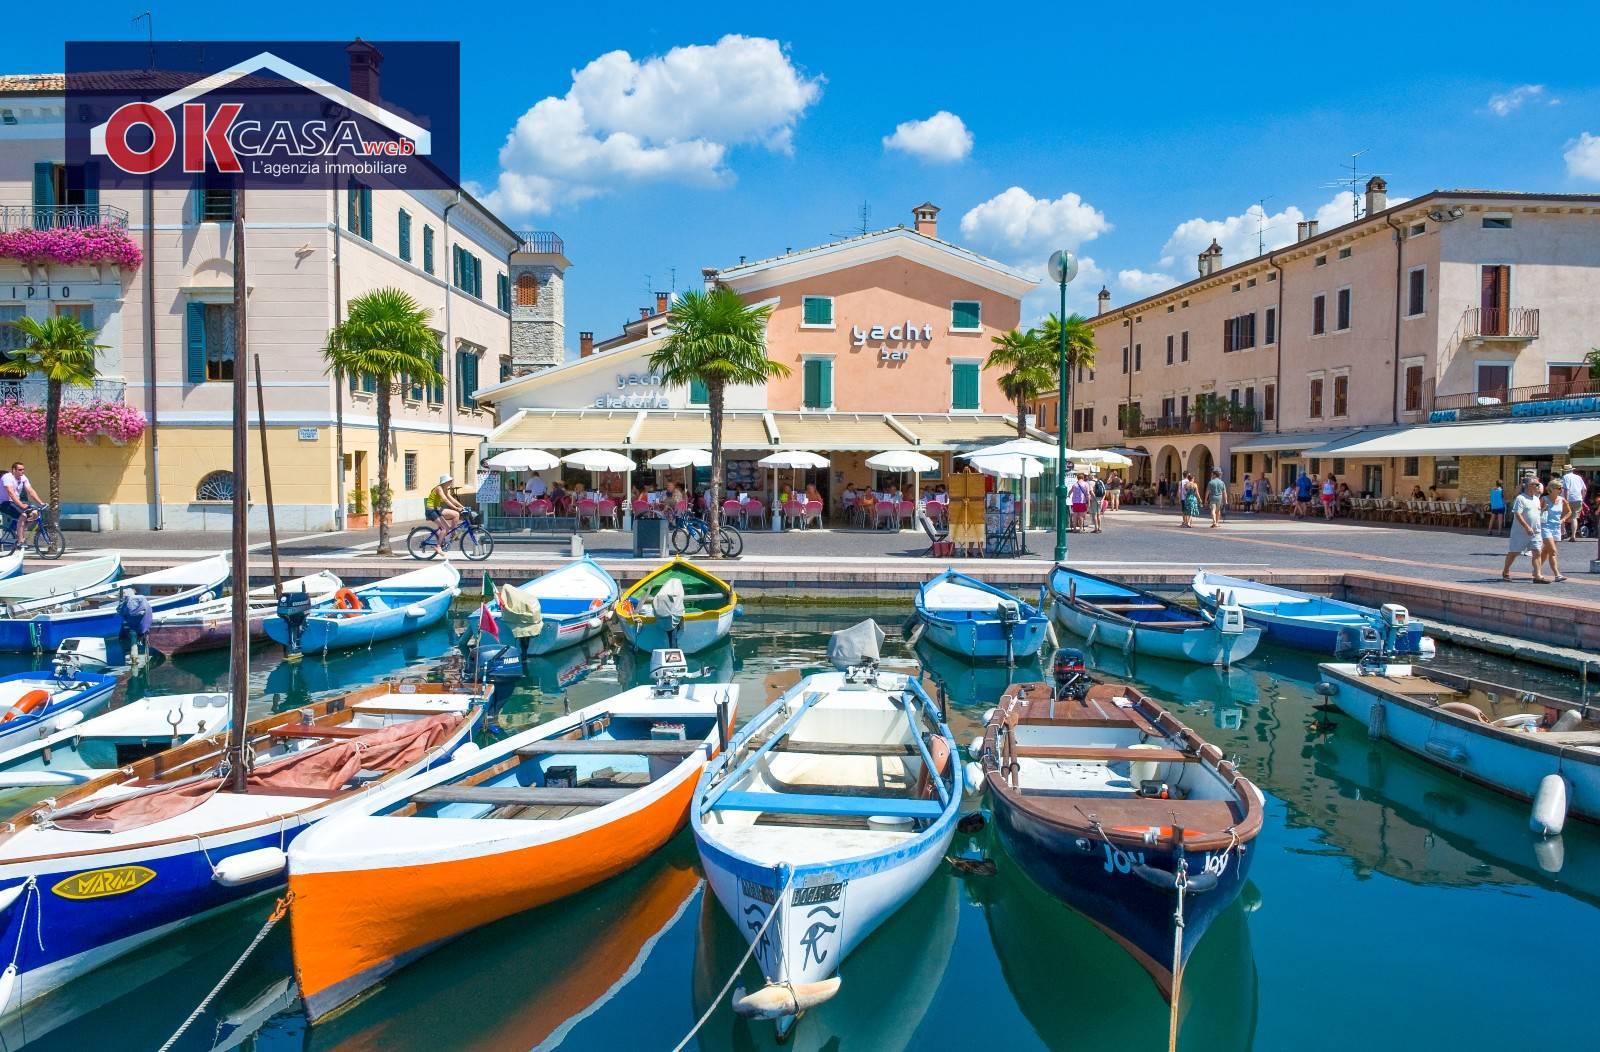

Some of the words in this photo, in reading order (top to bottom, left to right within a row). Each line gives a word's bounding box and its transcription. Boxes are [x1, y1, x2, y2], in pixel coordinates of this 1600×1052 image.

[852, 319, 934, 346] yacht
[880, 345, 909, 361] bar
[616, 373, 661, 390] yach
[78, 869, 138, 895] MARINA
